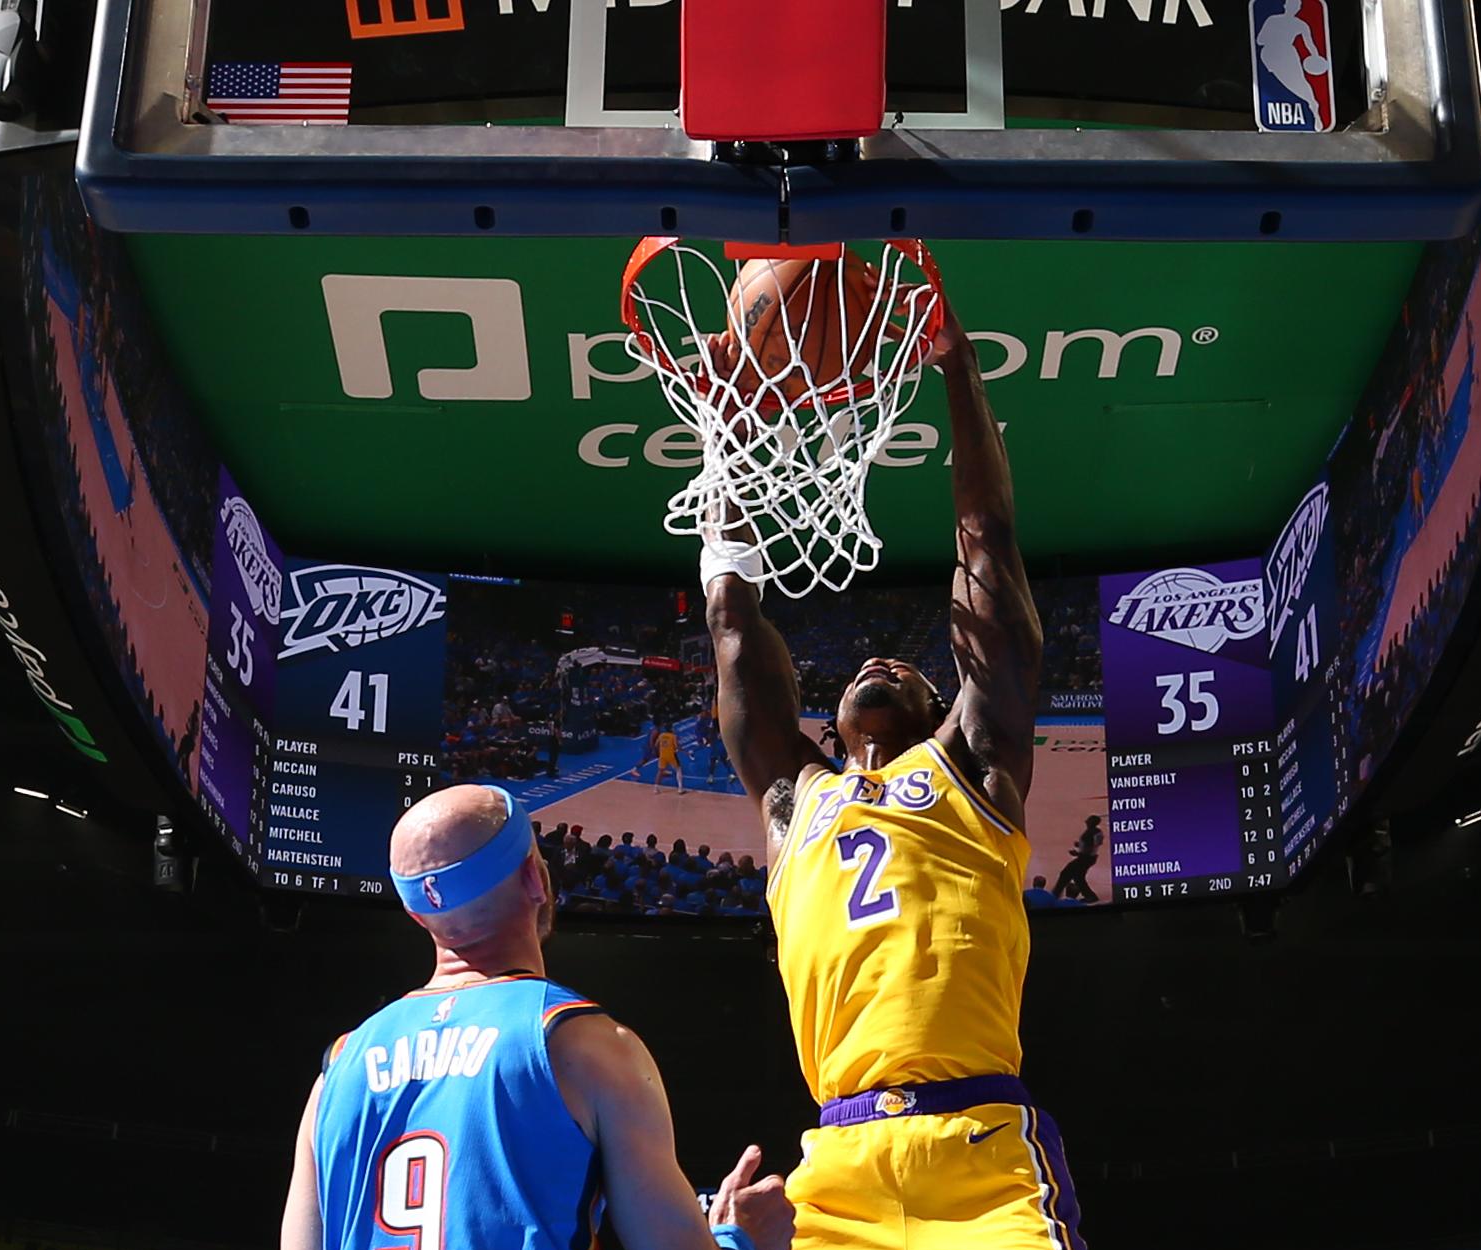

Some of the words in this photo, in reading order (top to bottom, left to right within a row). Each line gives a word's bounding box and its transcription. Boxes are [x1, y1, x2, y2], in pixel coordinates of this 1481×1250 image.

[1267, 101, 1306, 126] NBA
[1153, 592, 1181, 604] LOS
[1185, 583, 1260, 600] ANGELES
[1119, 594, 1260, 634] LAKERS
[226, 600, 255, 687] 35
[1295, 603, 1319, 683] 41
[330, 670, 389, 734] 41
[1156, 670, 1219, 734] 35
[276, 739, 318, 755] PLAYER
[398, 752, 419, 765] PTS
[423, 754, 437, 767] FL
[1111, 754, 1152, 768] PLAYER
[1233, 742, 1254, 756] PTS
[1258, 740, 1271, 753] FL
[273, 760, 317, 776] MCCAIN
[405, 775, 412, 786] 3
[426, 776, 431, 788] 1
[1110, 772, 1177, 790] VANDERBILT
[1242, 764, 1250, 777] 0
[1263, 762, 1269, 774] 1
[272, 782, 317, 799] CARUSO
[404, 796, 411, 808] 0
[1112, 797, 1146, 812] AYTON
[1241, 786, 1254, 799] 10
[1263, 784, 1271, 796] 2
[270, 804, 320, 821] WALLACE
[1113, 819, 1155, 833] REAVES
[1245, 808, 1252, 821] 2
[1267, 805, 1272, 818] 1
[269, 826, 323, 844] MITCHELL
[1113, 841, 1148, 855] JAMES
[1243, 830, 1258, 843] 12
[1266, 827, 1274, 841] 0
[267, 848, 342, 868] HARTENSTEIN
[1115, 860, 1181, 877] HACHIMURA
[1248, 853, 1256, 865] 6
[1268, 850, 1276, 863] 0
[274, 872, 288, 885] TO
[295, 873, 303, 886] 6
[311, 876, 325, 889] TF
[332, 878, 338, 890] 1
[360, 880, 383, 894] 2ND
[836, 824, 903, 932] 2
[1123, 887, 1138, 900] TO
[1144, 885, 1152, 898] 5
[1161, 883, 1175, 897] TF
[1180, 882, 1188, 895] 2
[1209, 877, 1232, 892] 2ND
[1247, 873, 1272, 888] 7:47
[364, 1024, 501, 1094] CARUSO
